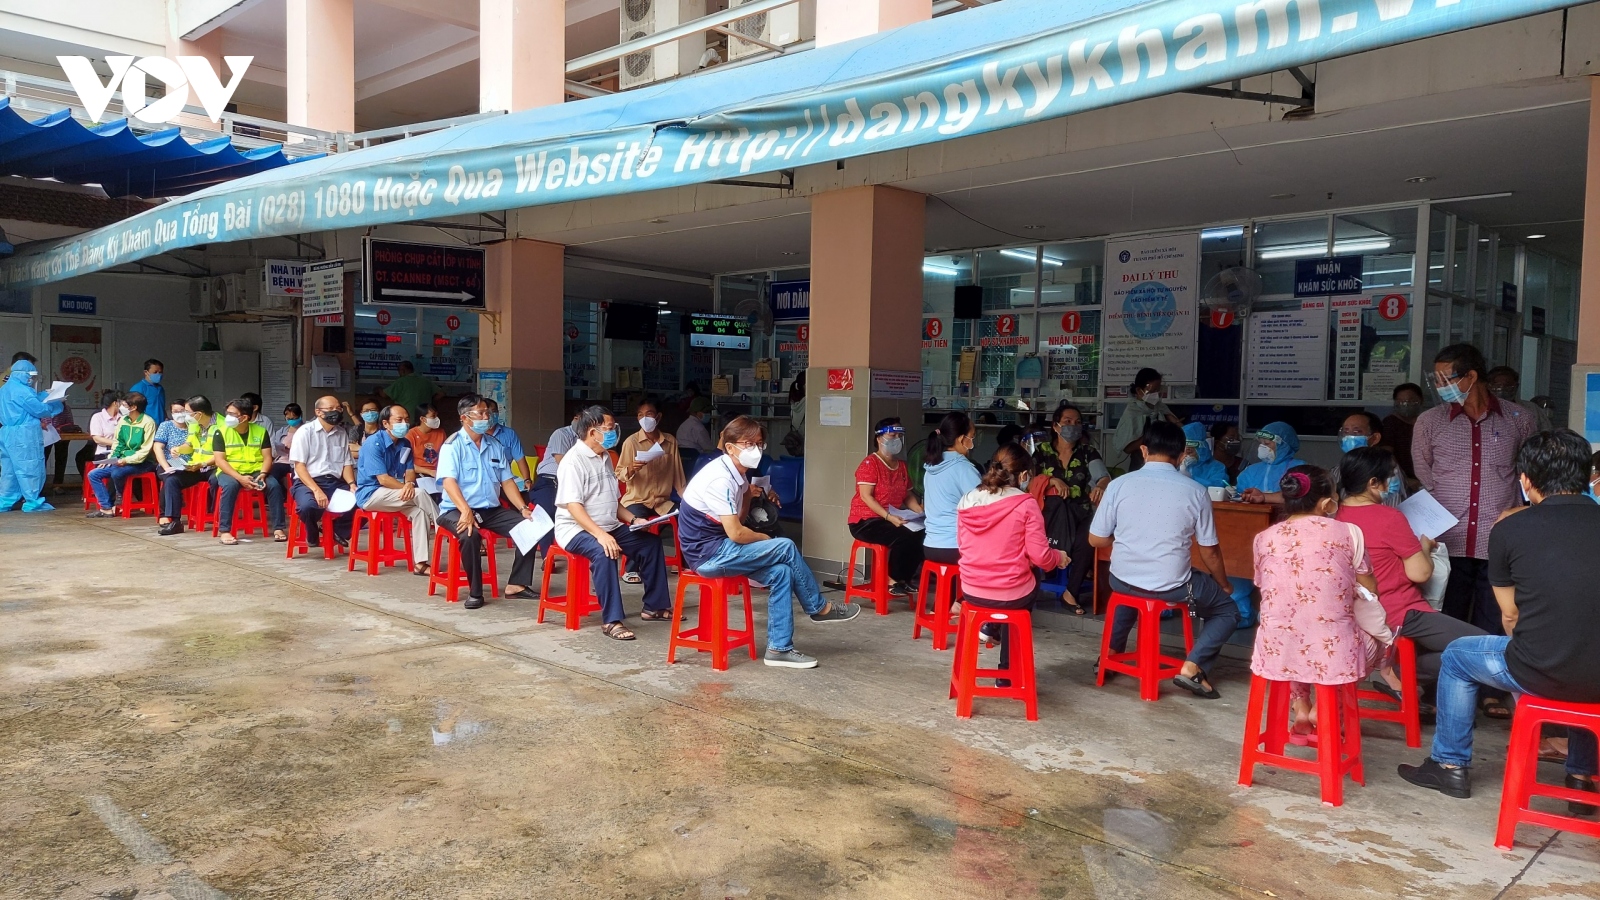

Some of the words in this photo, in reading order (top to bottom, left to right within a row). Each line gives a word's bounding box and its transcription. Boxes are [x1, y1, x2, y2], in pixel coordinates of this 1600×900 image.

[52, 254, 62, 276] Có
[82, 242, 105, 267] Đăng
[107, 237, 119, 262] Ký
[121, 226, 151, 255] Khám
[154, 219, 178, 247] Qua
[182, 203, 218, 240] Tổng
[224, 199, 252, 232] Đài
[258, 190, 305, 233] (028)
[315, 180, 366, 220] 1080
[374, 171, 437, 216] Hoặc
[444, 165, 503, 206] Qua
[514, 141, 663, 194] Website
[673, 0, 1459, 174] Http://dangkykham.
[374, 248, 402, 262] PHÒNG
[405, 252, 424, 268] CHỤP
[427, 250, 441, 266] CẮT
[458, 258, 466, 268] VI
[467, 256, 482, 269] TÍNH
[270, 264, 289, 274] NHÀ
[1316, 260, 1341, 276] NHẬN
[272, 276, 296, 288] BỆNH
[376, 270, 389, 282] CT.
[392, 270, 432, 285] SCANNER
[434, 274, 460, 288] (MSCT
[1122, 274, 1139, 284] ĐẠI
[1142, 270, 1155, 280] LÝ
[1158, 270, 1179, 279] THU
[1298, 278, 1320, 292] KHÁM
[1321, 277, 1336, 292] SỨC
[1338, 275, 1358, 290] KHỎE
[62, 300, 75, 309] KHO
[76, 301, 93, 311] DƯỢC
[777, 290, 790, 310] NƠI
[792, 288, 809, 309] ĐĂN
[1386, 298, 1399, 318] 8
[380, 314, 389, 322] 09
[450, 319, 458, 328] 10
[1068, 314, 1075, 330] 1
[1217, 308, 1227, 326] 7
[932, 320, 939, 336] 3
[1002, 318, 1010, 333] 2
[801, 326, 807, 340] 5
[922, 340, 932, 348] THU
[934, 337, 948, 348] TIỀN
[1016, 335, 1029, 346] BỆNH
[1048, 335, 1070, 347] NHẬN
[1072, 334, 1094, 347] BỆNH
[369, 350, 377, 360] CẤP
